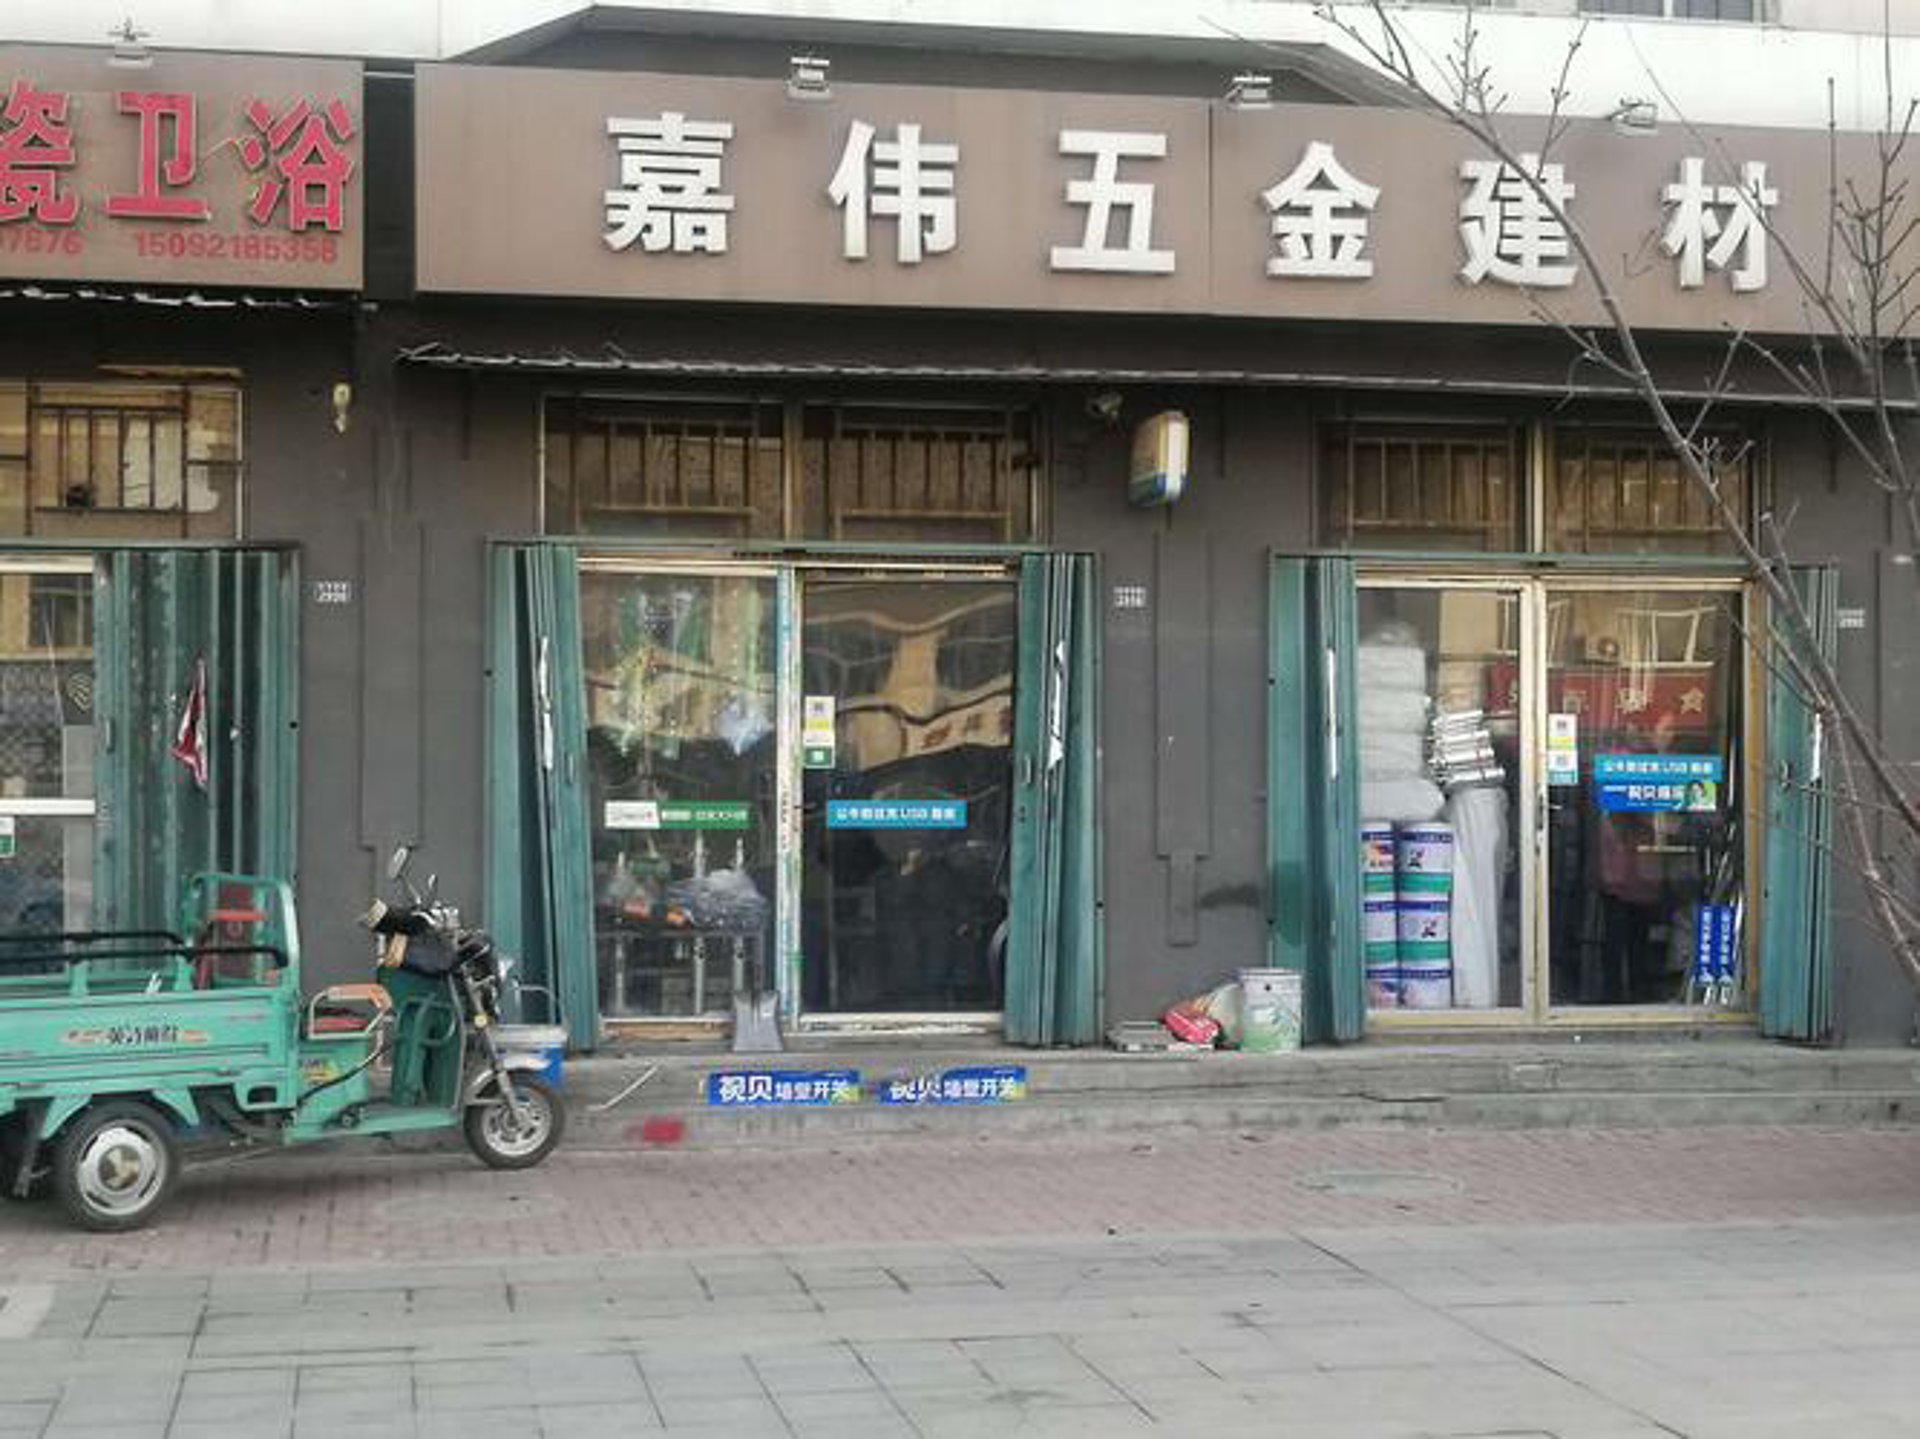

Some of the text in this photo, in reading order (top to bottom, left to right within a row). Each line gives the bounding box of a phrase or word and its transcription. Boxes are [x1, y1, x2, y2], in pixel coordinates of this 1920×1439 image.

[0, 79, 354, 233] 瓷卫浴
[603, 111, 1779, 292] 嘉伟五金建材
